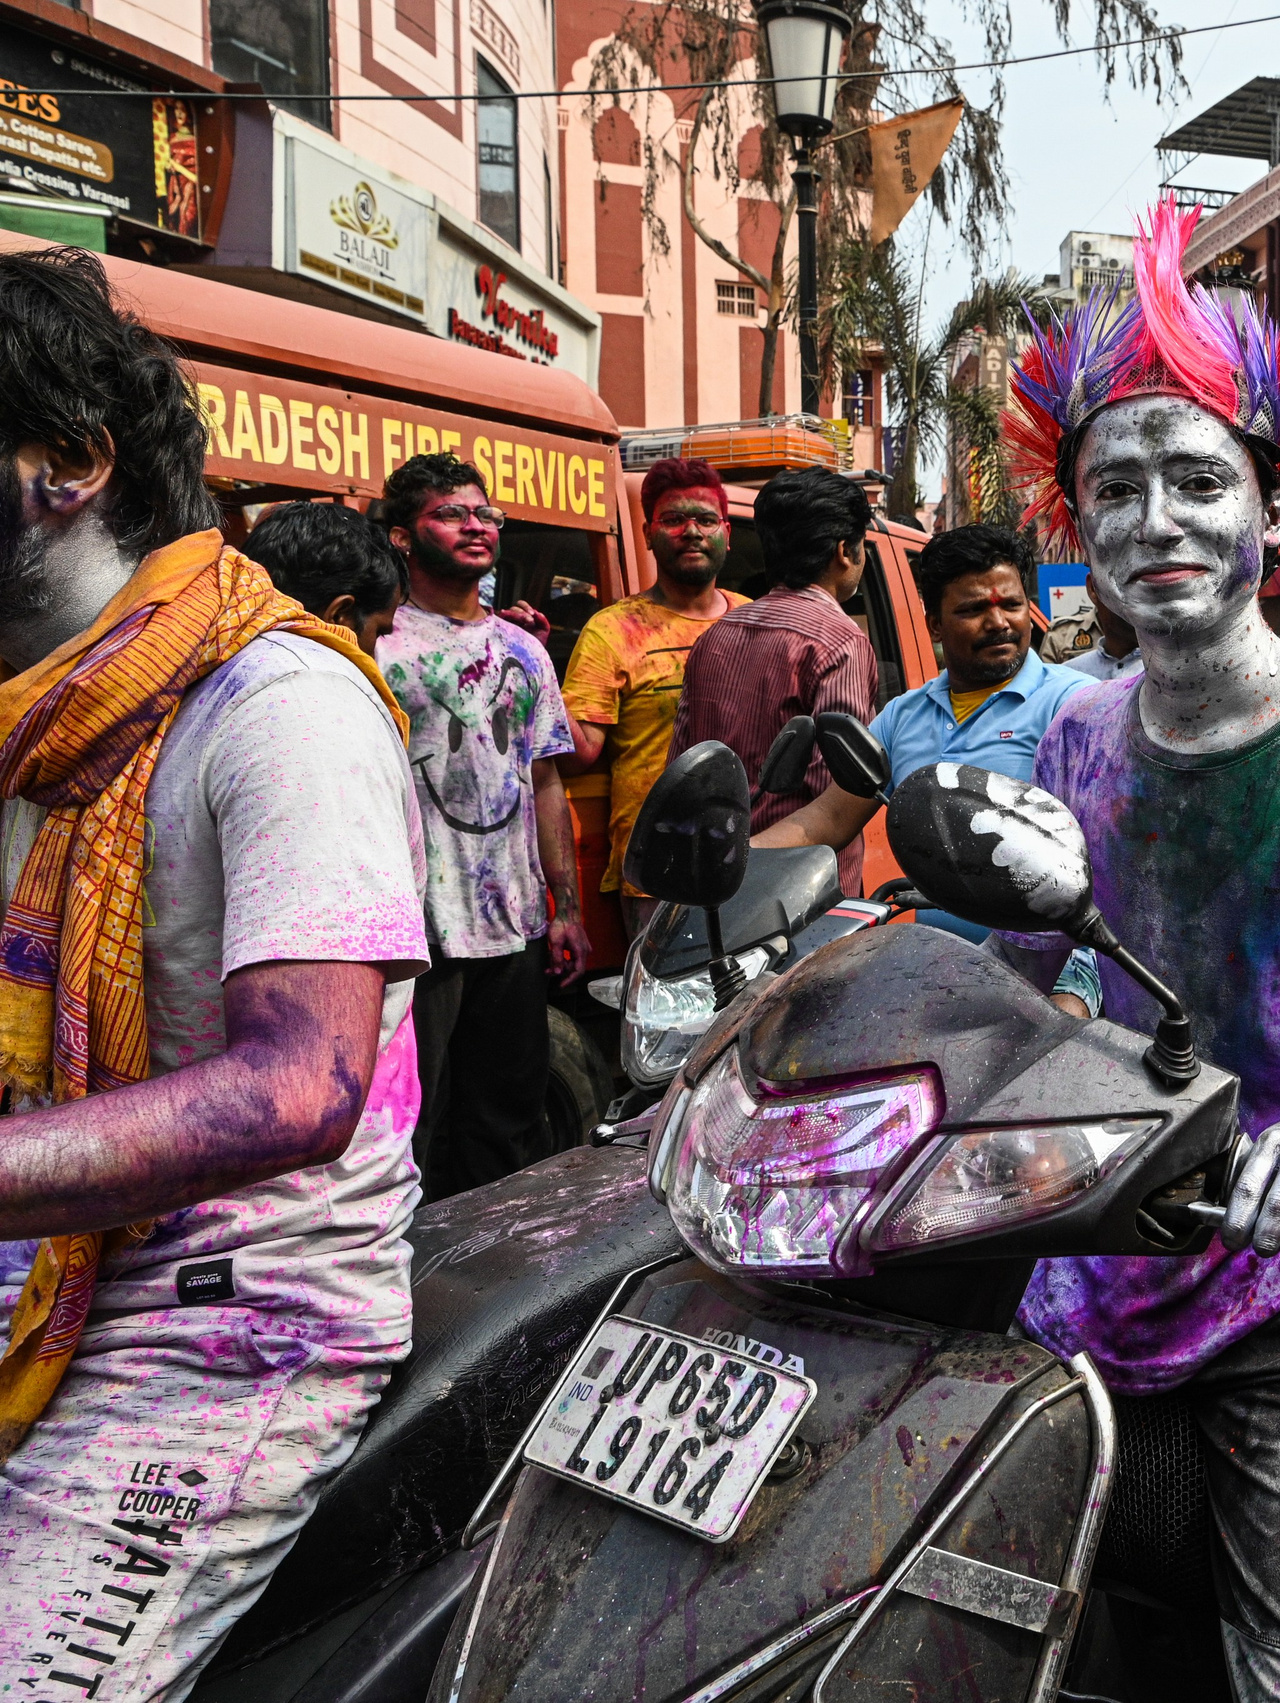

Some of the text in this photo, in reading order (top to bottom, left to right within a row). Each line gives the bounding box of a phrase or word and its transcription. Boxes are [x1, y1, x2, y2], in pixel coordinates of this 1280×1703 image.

[10, 118, 55, 144] Cotton
[29, 141, 80, 169] Dupatta
[81, 160, 107, 177] etc.
[81, 182, 130, 210] Varanasi
[340, 231, 389, 271] BALAJI
[188, 382, 370, 480] RADESH
[474, 436, 606, 518] SERVICE
[186, 1275, 222, 1288] SAVAGE
[700, 1327, 805, 1375] HONDA
[569, 1381, 593, 1401] IND
[613, 1332, 777, 1441] UP65D
[130, 1462, 172, 1487] LEE
[566, 1403, 734, 1521] L9164
[118, 1489, 201, 1521] COOPER
